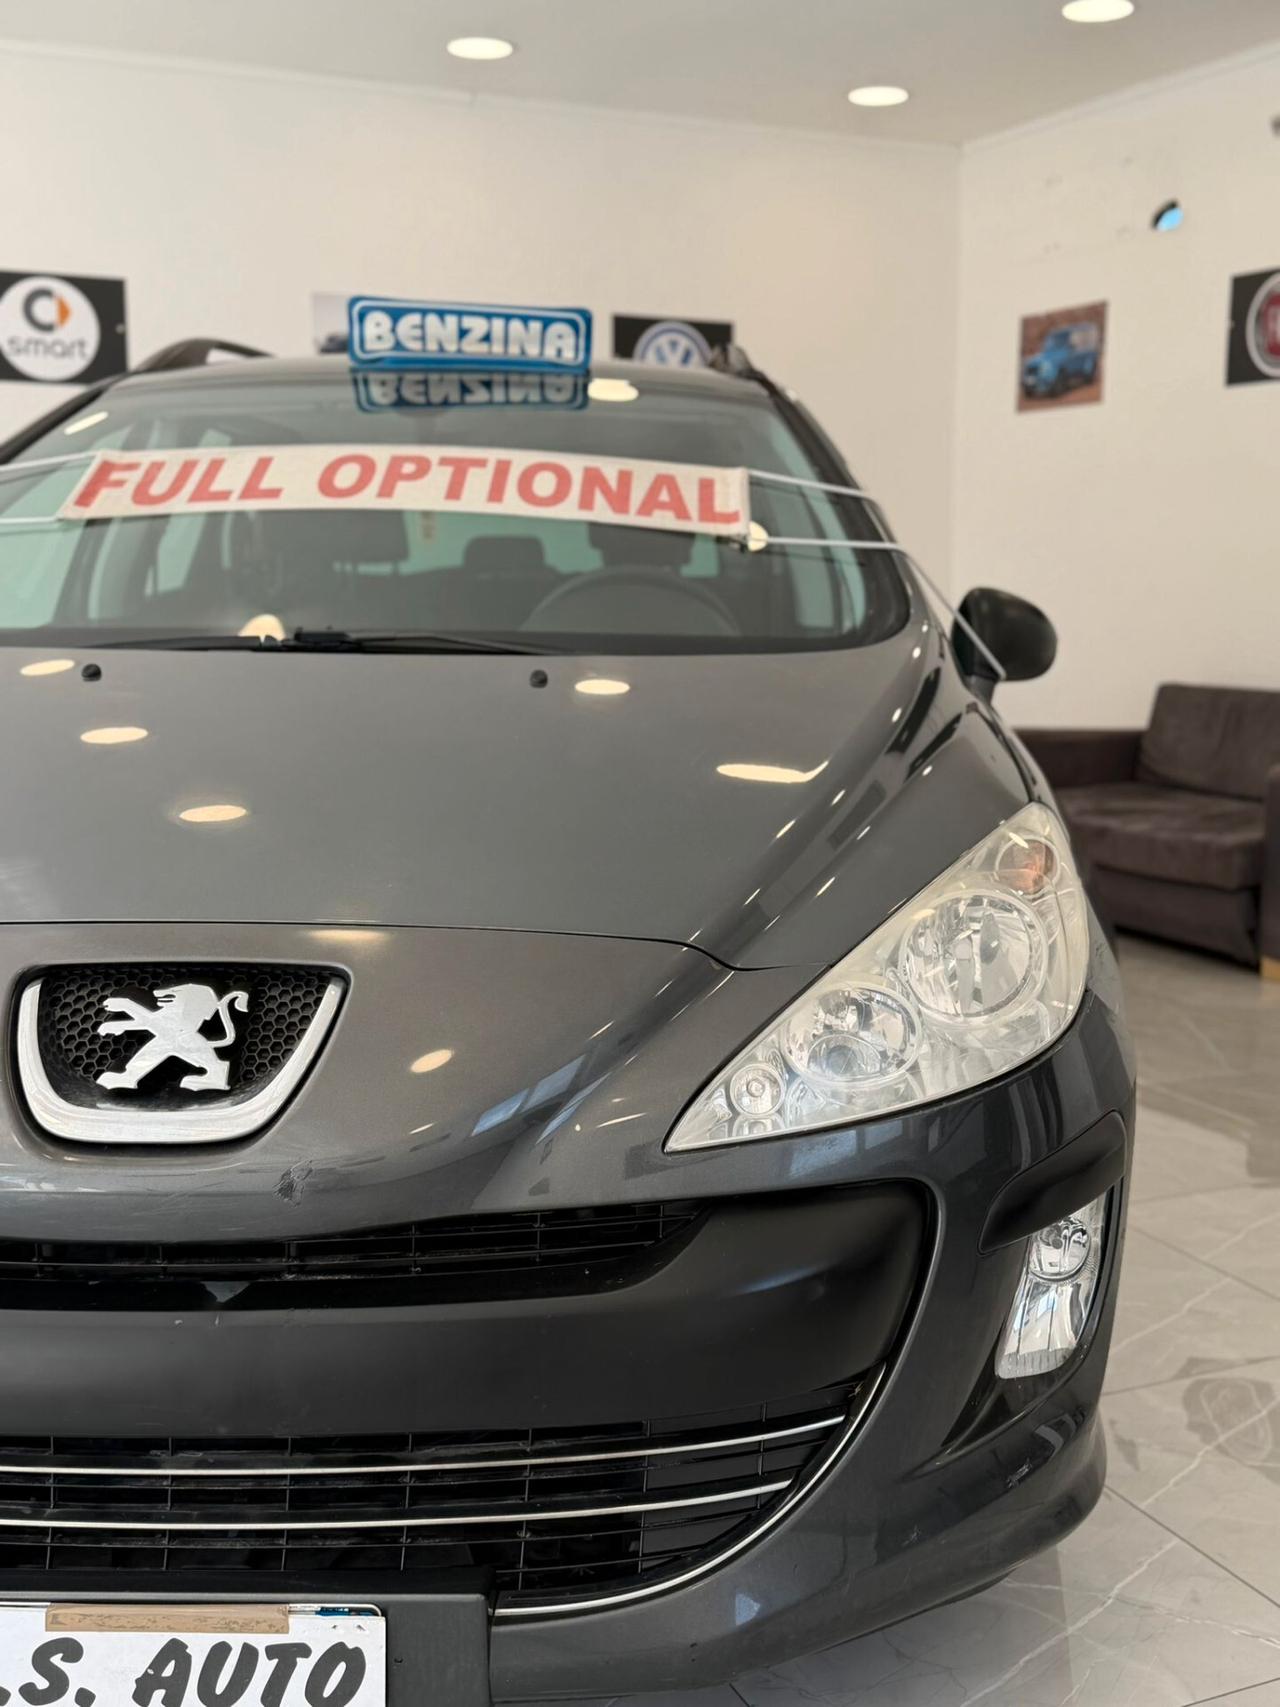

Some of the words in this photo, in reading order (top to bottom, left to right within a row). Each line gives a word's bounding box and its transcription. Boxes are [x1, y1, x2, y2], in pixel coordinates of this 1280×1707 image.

[7, 334, 88, 360] smart
[363, 310, 577, 361] BENZINA
[73, 456, 285, 508] FULL
[317, 454, 740, 524] OPTIONAL
[132, 1637, 367, 1707] AUTO
